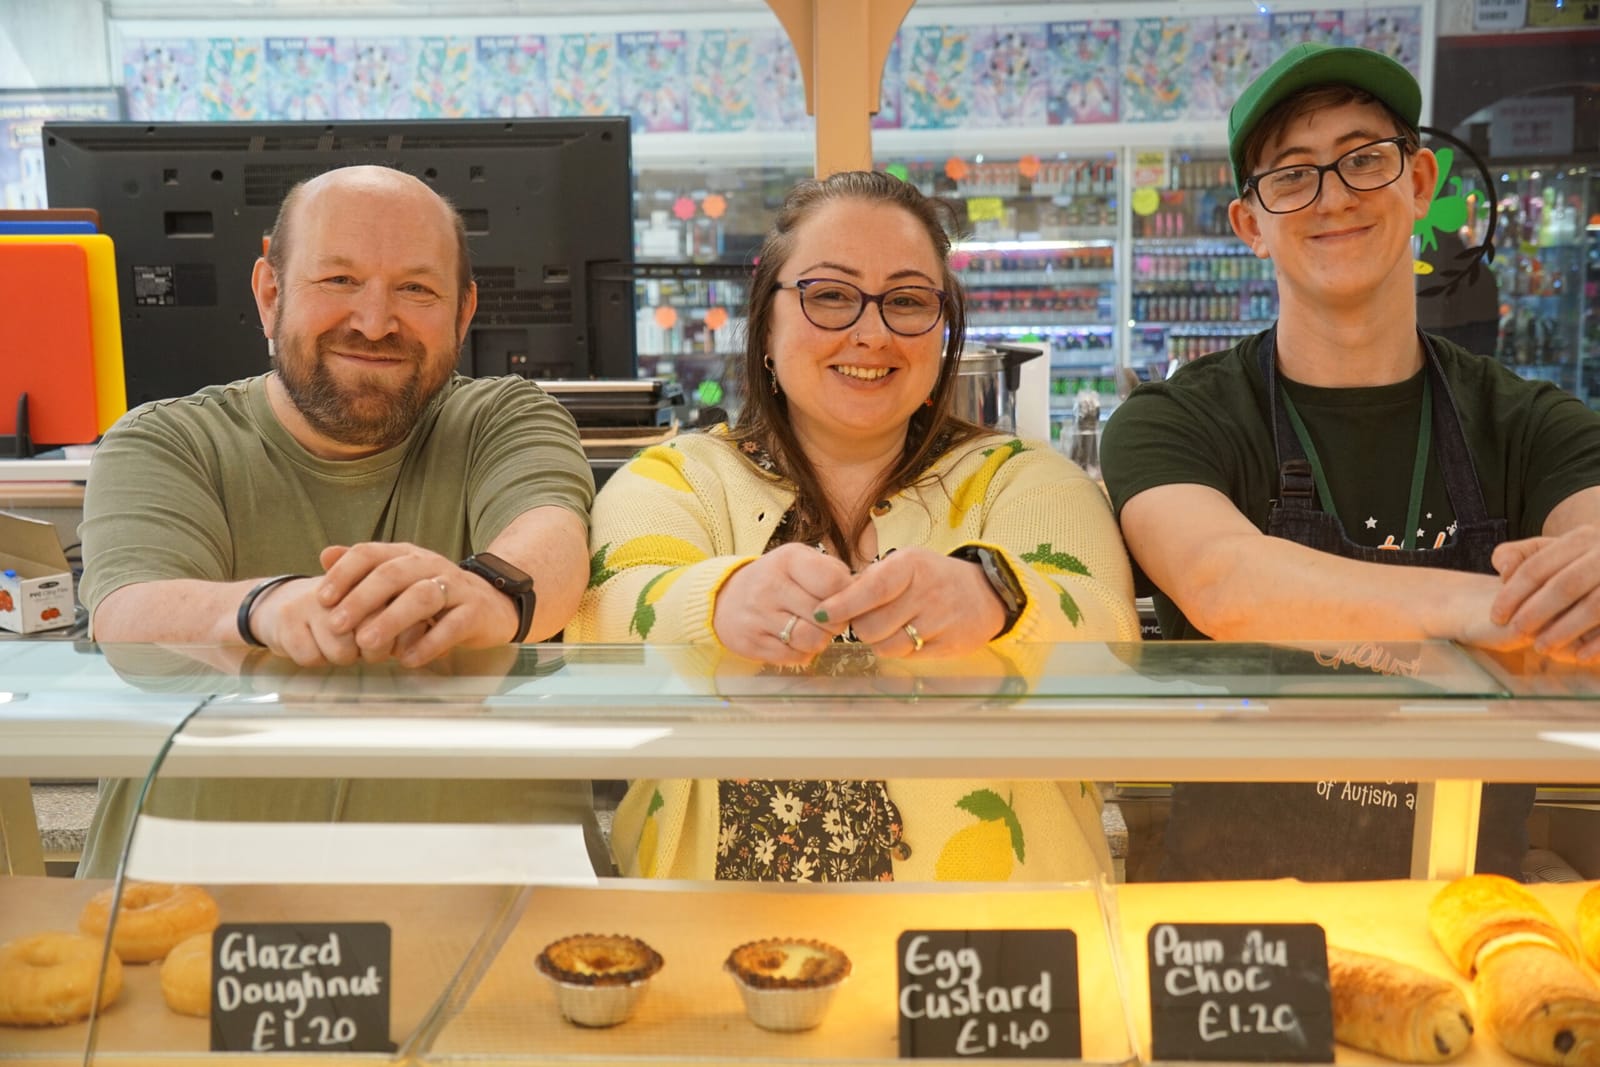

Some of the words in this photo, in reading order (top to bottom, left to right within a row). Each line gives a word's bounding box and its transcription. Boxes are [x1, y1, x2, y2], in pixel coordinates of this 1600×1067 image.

[1316, 780, 1336, 801] of
[1341, 780, 1398, 808] Autism
[219, 931, 341, 973] Glazed
[904, 935, 982, 989] Egg
[1154, 924, 1225, 967] Pain
[1241, 930, 1288, 967] Au
[217, 965, 382, 1019] Doughnut
[900, 971, 1051, 1019] Custard
[252, 1011, 357, 1051] £1.20
[956, 1018, 1050, 1055] £1.40
[1198, 1000, 1296, 1042] £1.20
